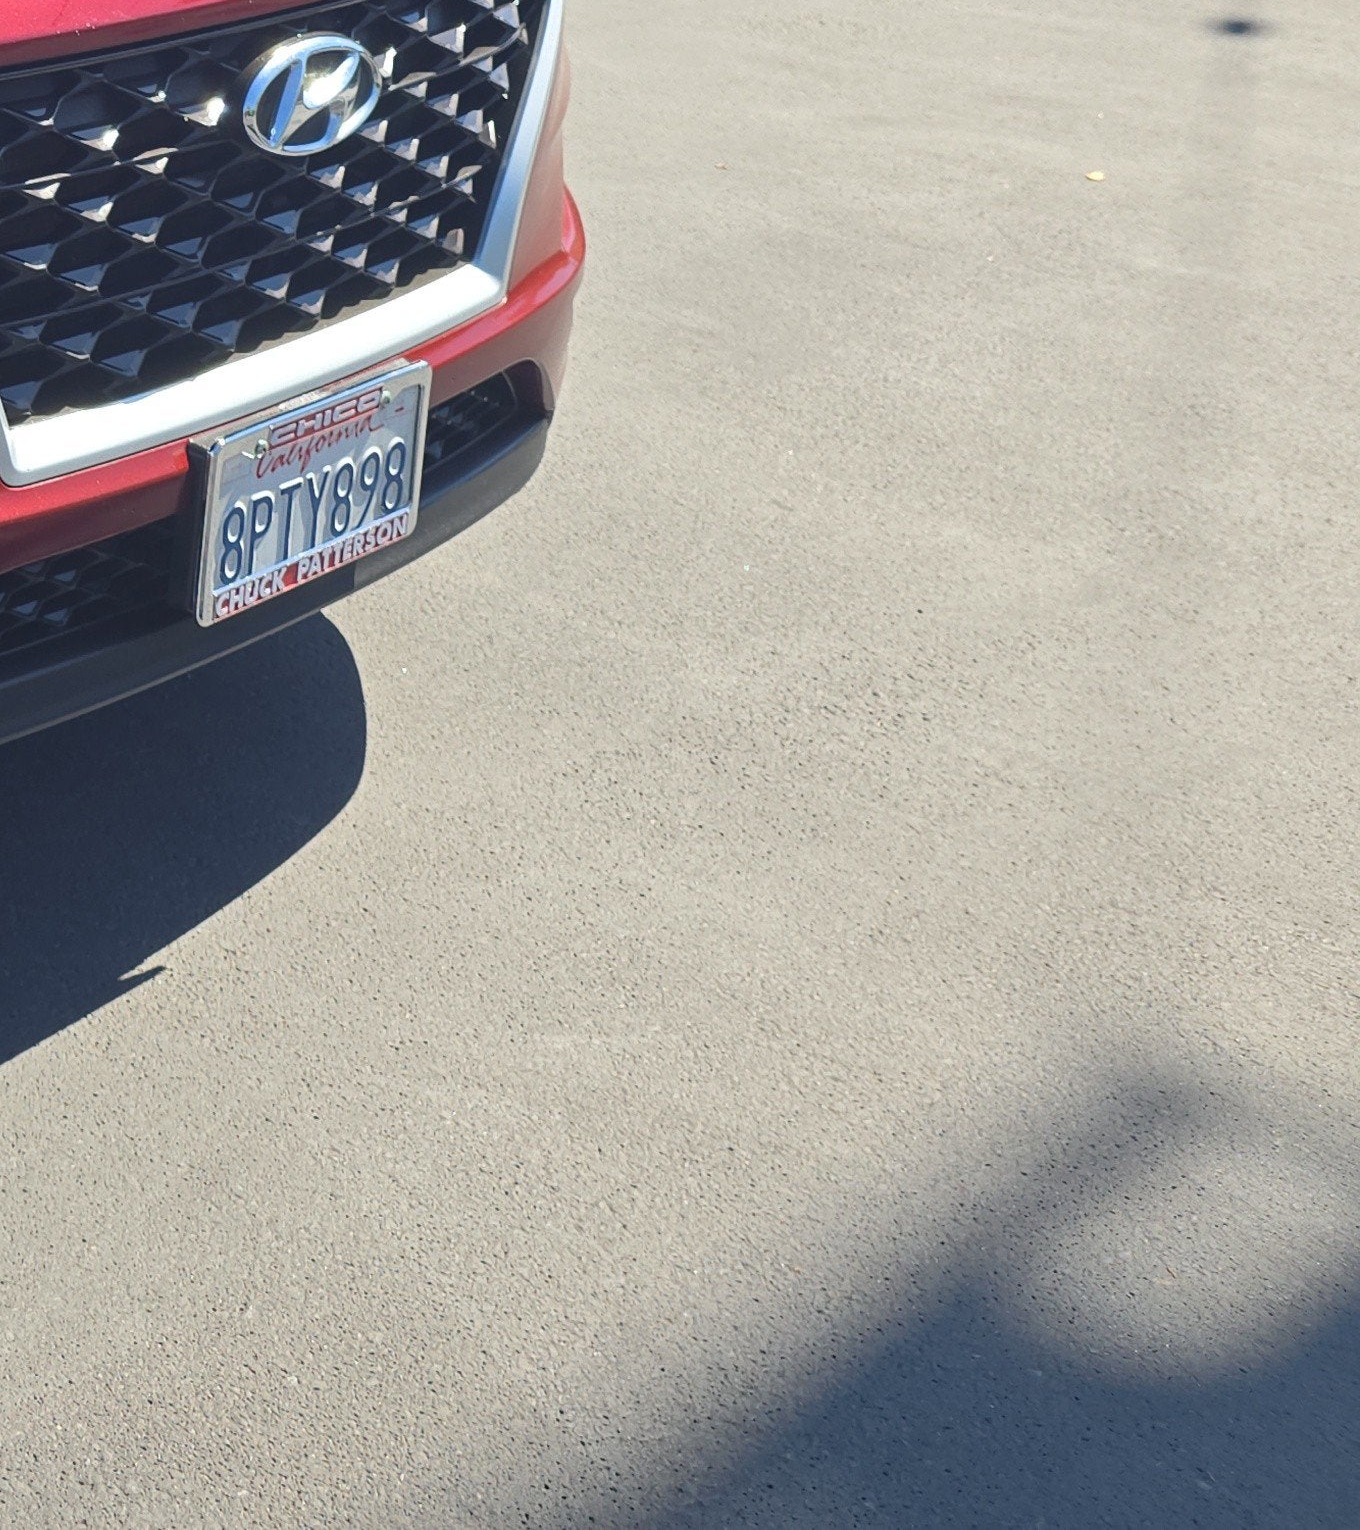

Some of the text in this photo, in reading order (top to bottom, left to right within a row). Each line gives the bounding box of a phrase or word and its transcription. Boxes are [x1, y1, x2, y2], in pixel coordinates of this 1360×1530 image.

[256, 416, 386, 479] California
[270, 390, 383, 444] CHICO
[221, 436, 406, 586] 8PTY898
[215, 513, 408, 618] CHUCK PATTERSON
